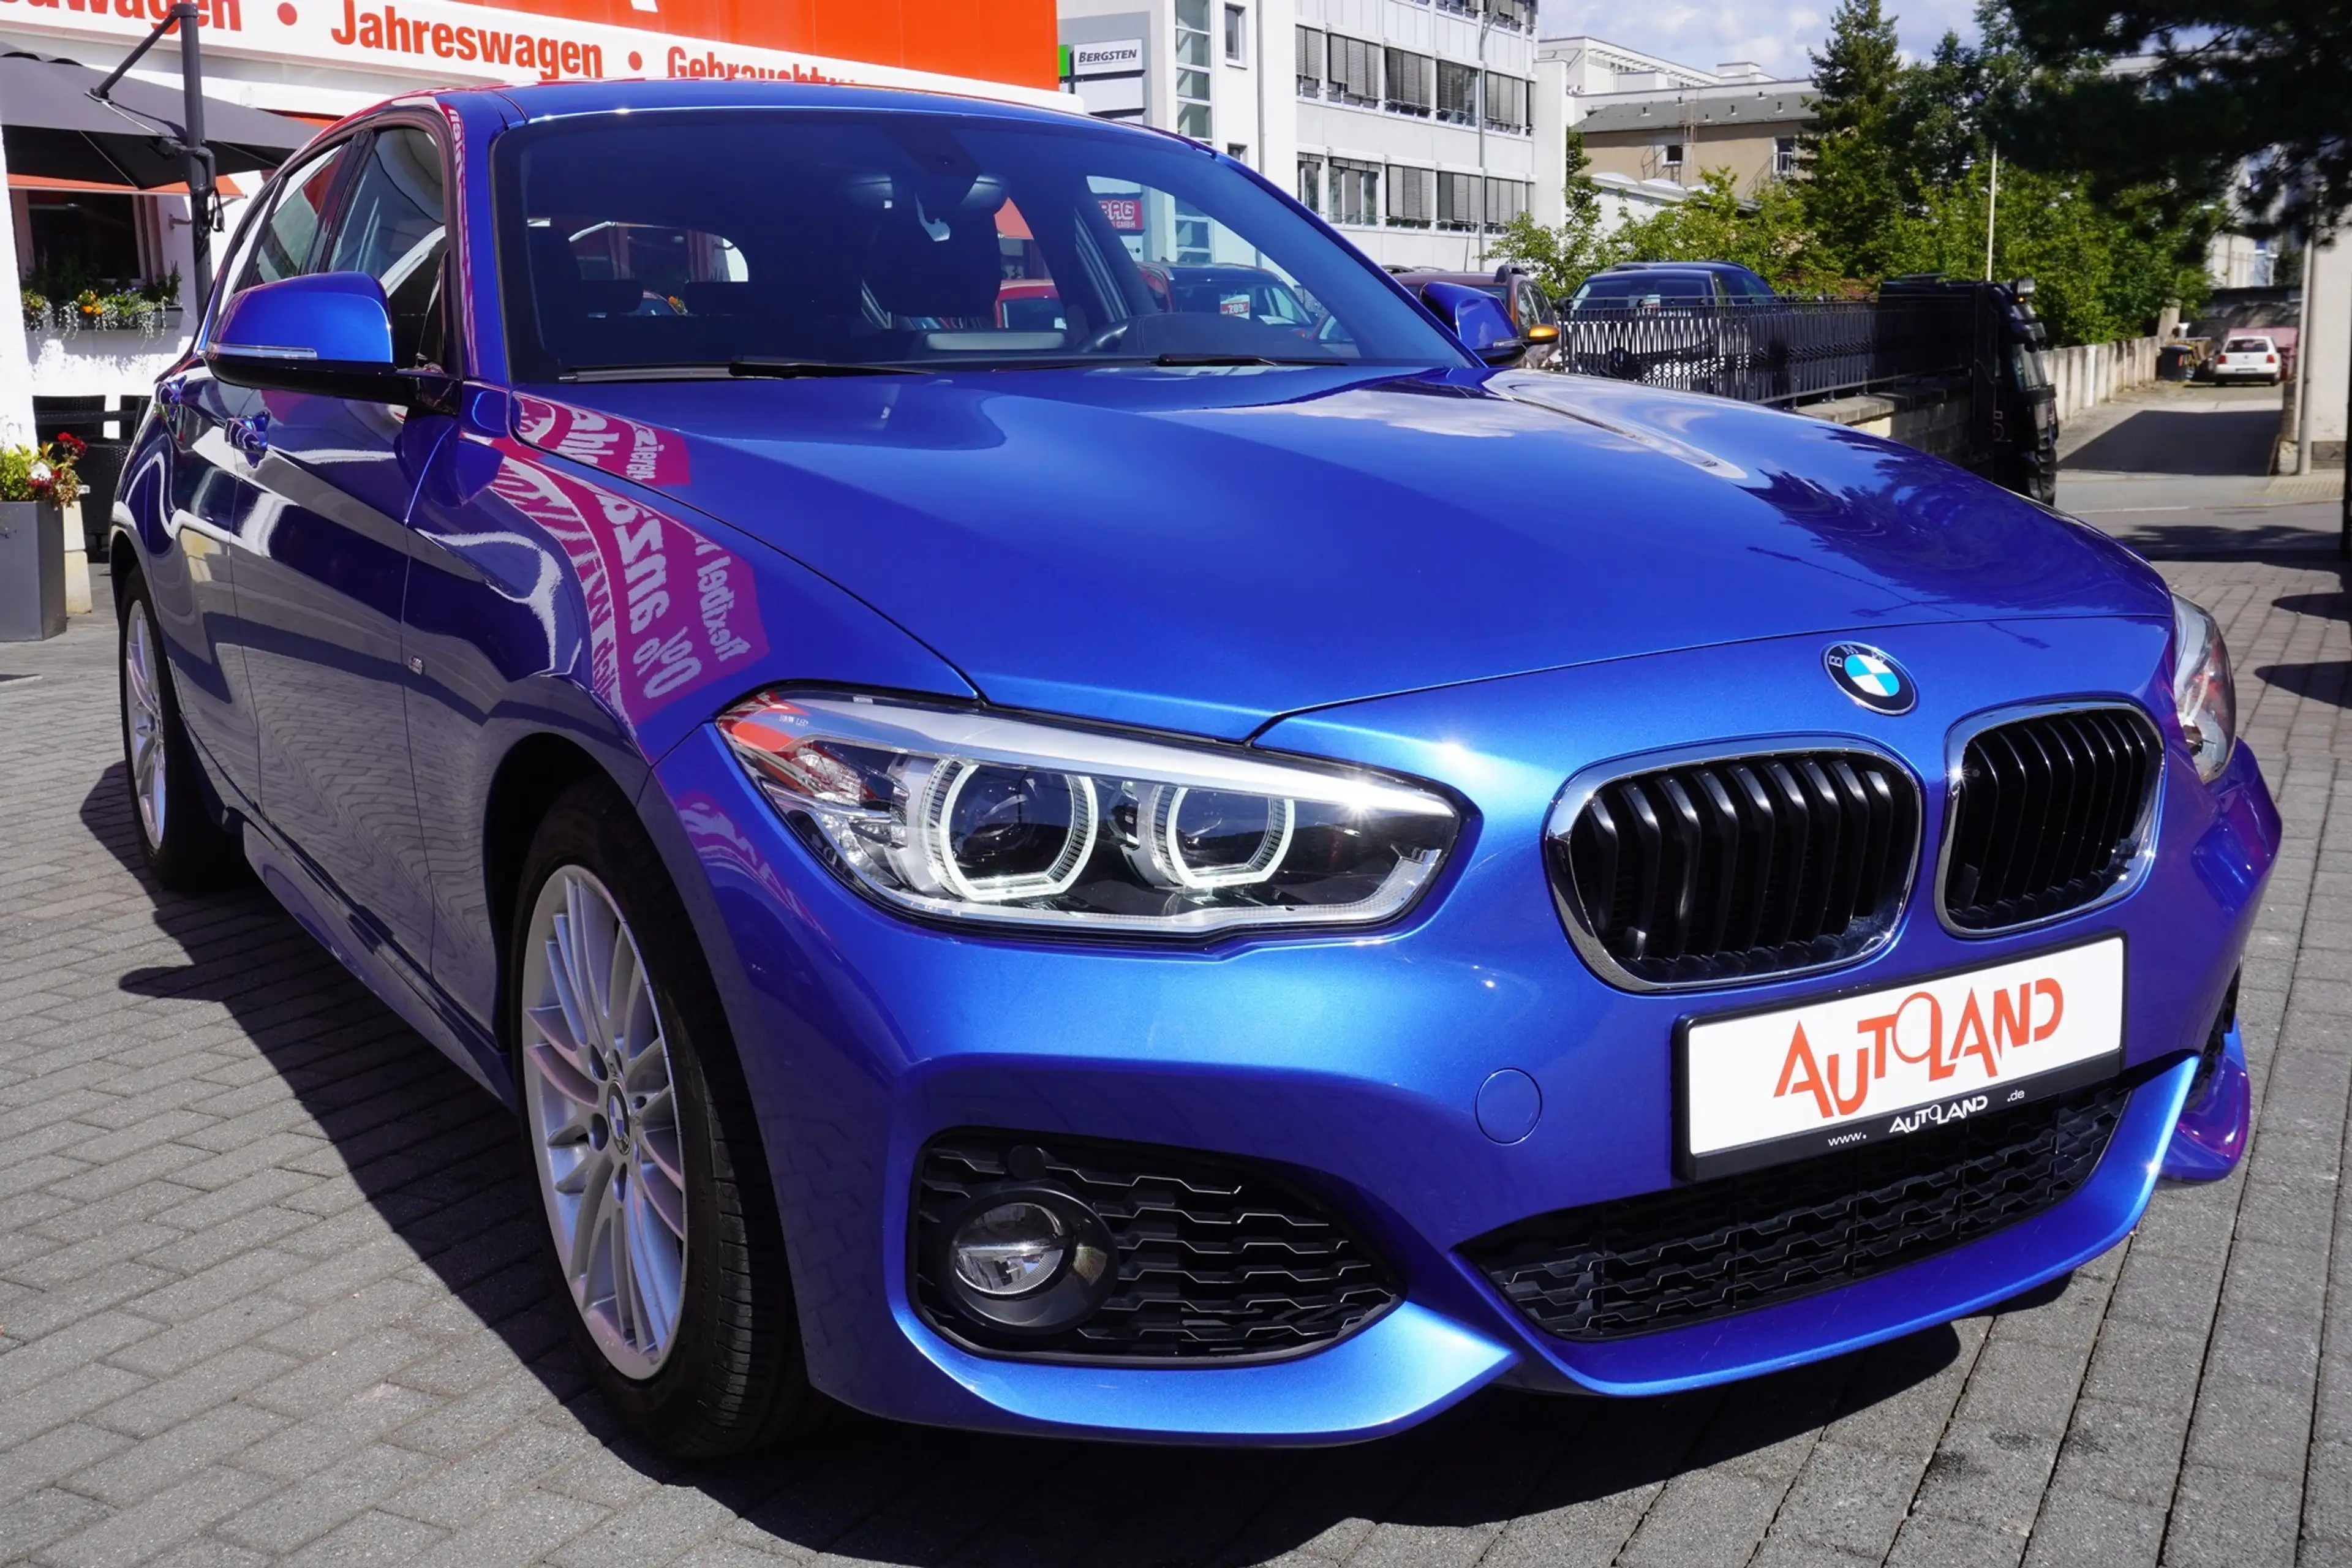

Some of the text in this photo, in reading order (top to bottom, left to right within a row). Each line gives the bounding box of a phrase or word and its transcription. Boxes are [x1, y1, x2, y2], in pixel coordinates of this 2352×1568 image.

[331, 0, 603, 80] Jahreswagen
[1079, 49, 1137, 63] BERGSTEN
[1828, 644, 1887, 668] BMW
[1773, 977, 2064, 1119] AUTOLAND
[1828, 1090, 2025, 1147] www. AUTOLAND .de
